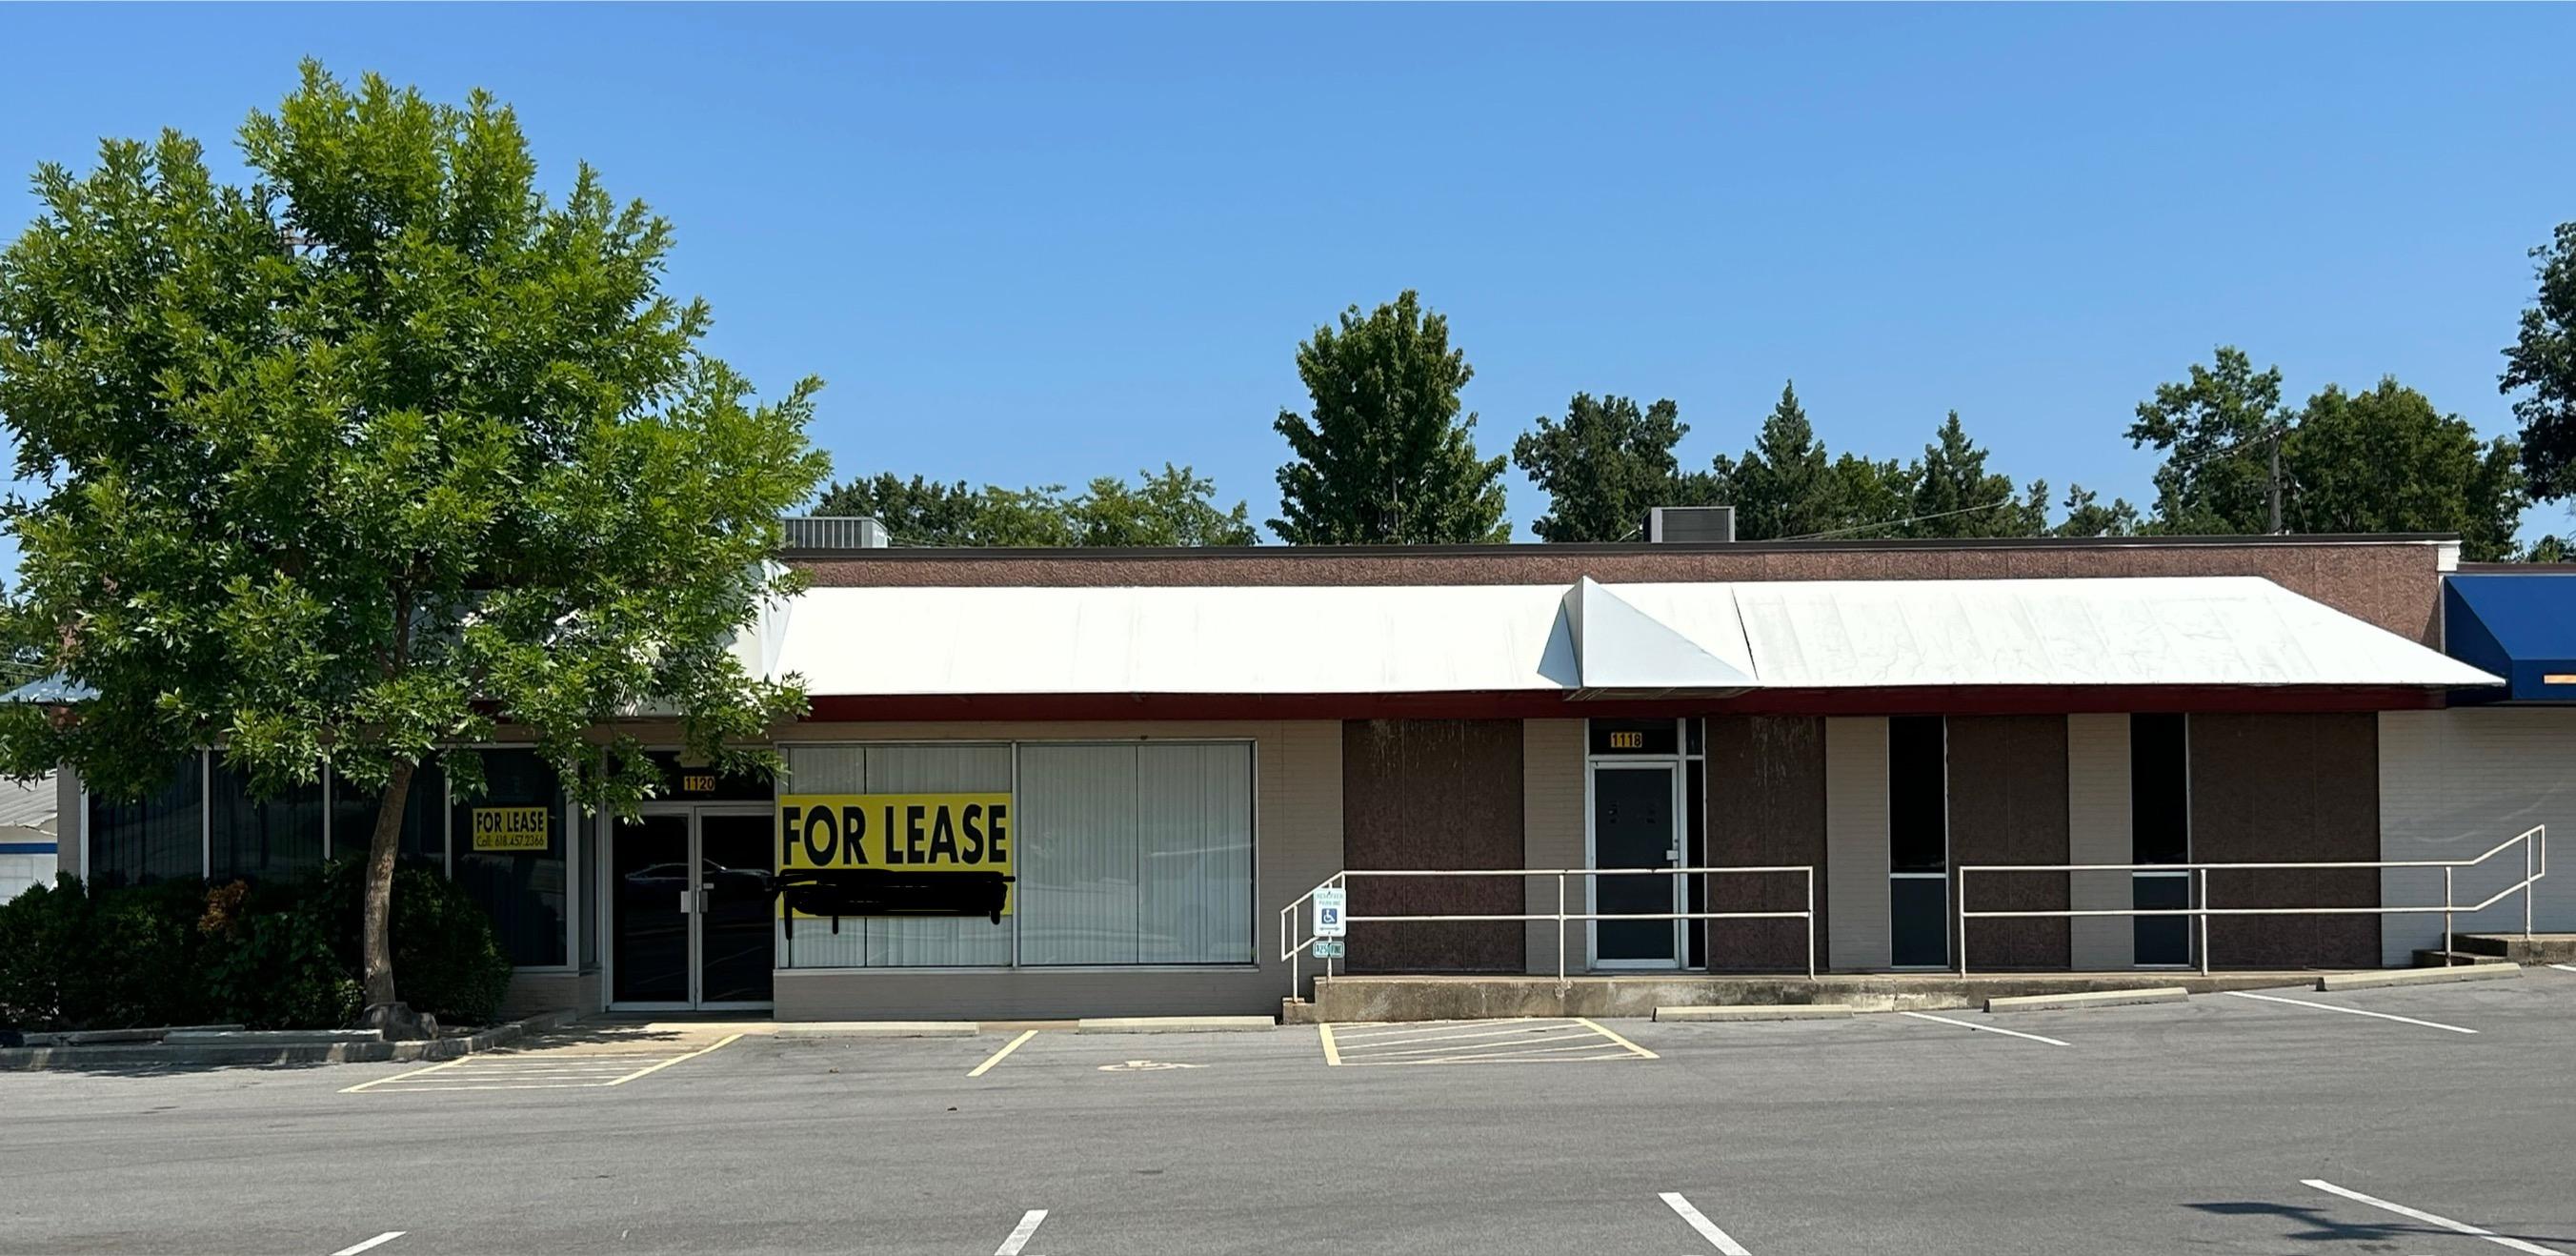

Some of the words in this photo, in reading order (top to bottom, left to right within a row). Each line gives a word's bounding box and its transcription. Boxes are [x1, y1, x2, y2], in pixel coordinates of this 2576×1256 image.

[1612, 733, 1641, 747] 1118
[685, 777, 714, 790] 1120
[476, 811, 502, 833] FOR
[507, 811, 544, 833] LEASE
[494, 834, 544, 847] 618.457.2366
[782, 804, 870, 867] FOR
[884, 803, 1007, 865] LEASE
